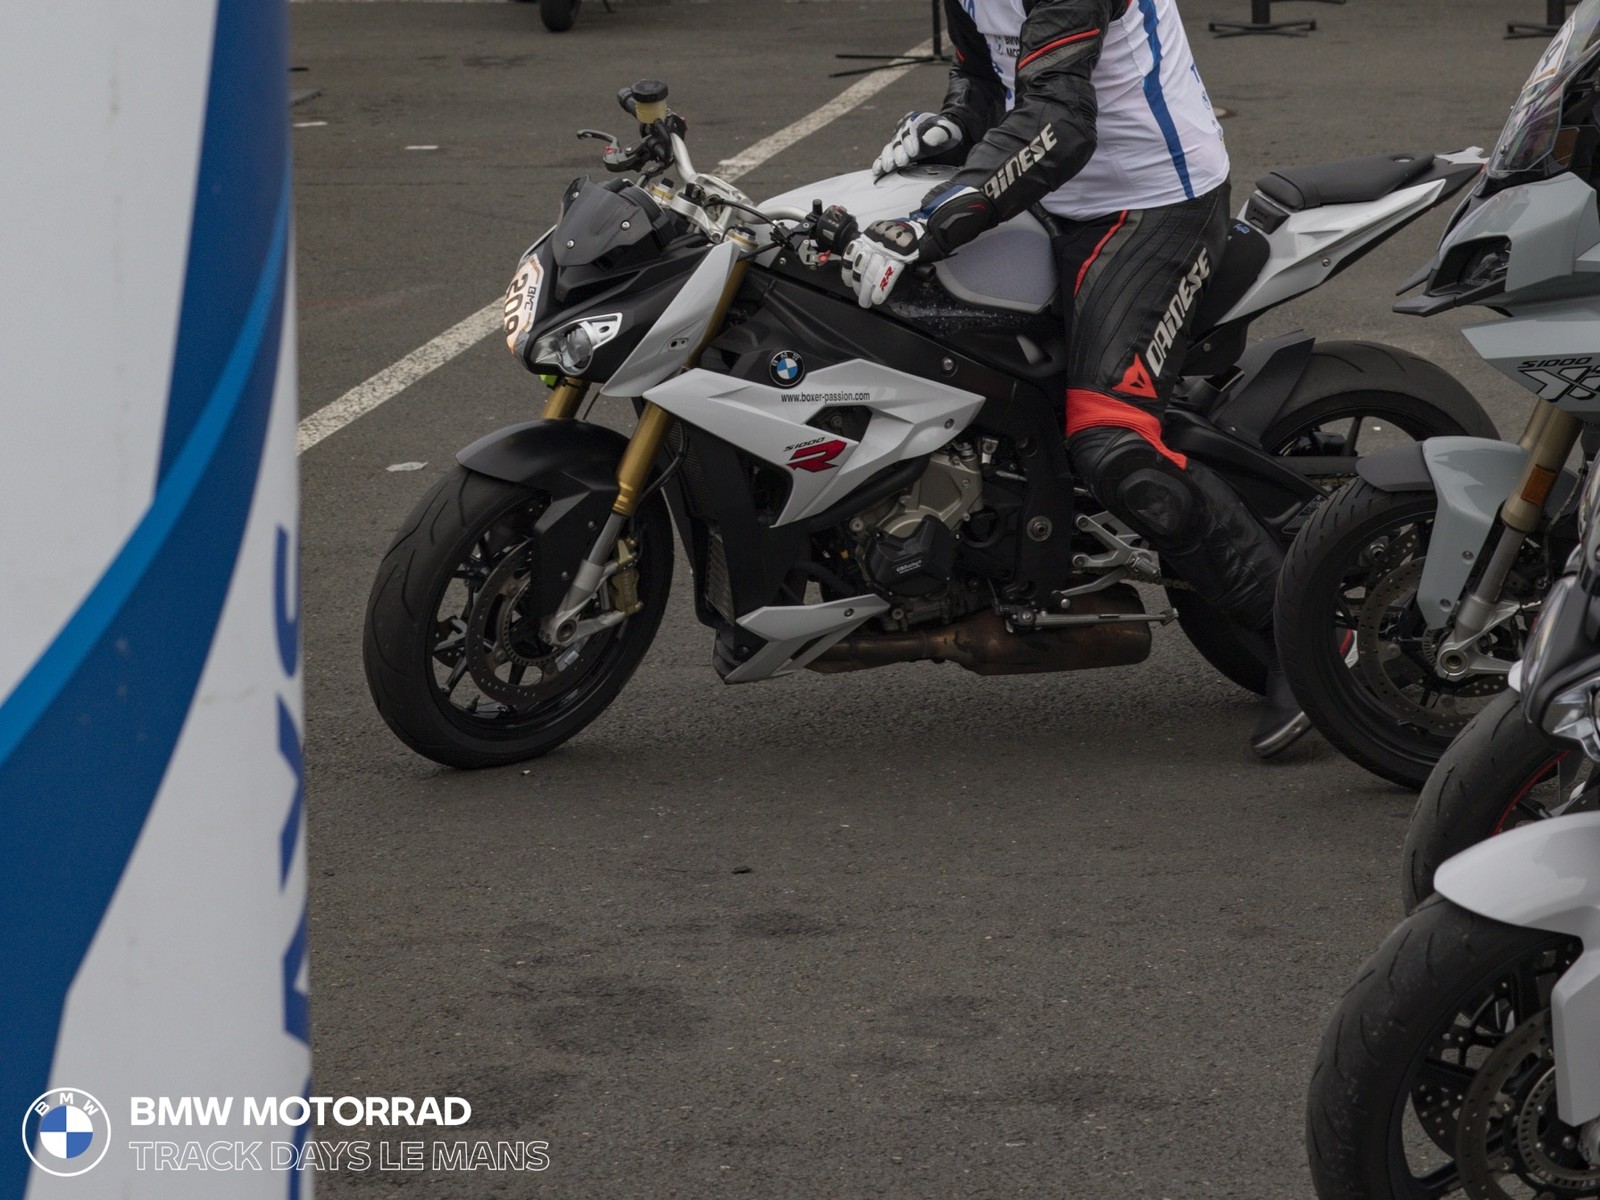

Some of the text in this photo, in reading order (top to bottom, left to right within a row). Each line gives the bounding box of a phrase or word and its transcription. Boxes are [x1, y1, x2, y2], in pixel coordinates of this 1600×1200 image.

[980, 122, 1058, 200] AINESE
[1145, 246, 1210, 378] DAINESE
[1517, 357, 1593, 369] S1000
[780, 390, 871, 404] www.boxer-passion.com
[783, 436, 826, 452] S1000
